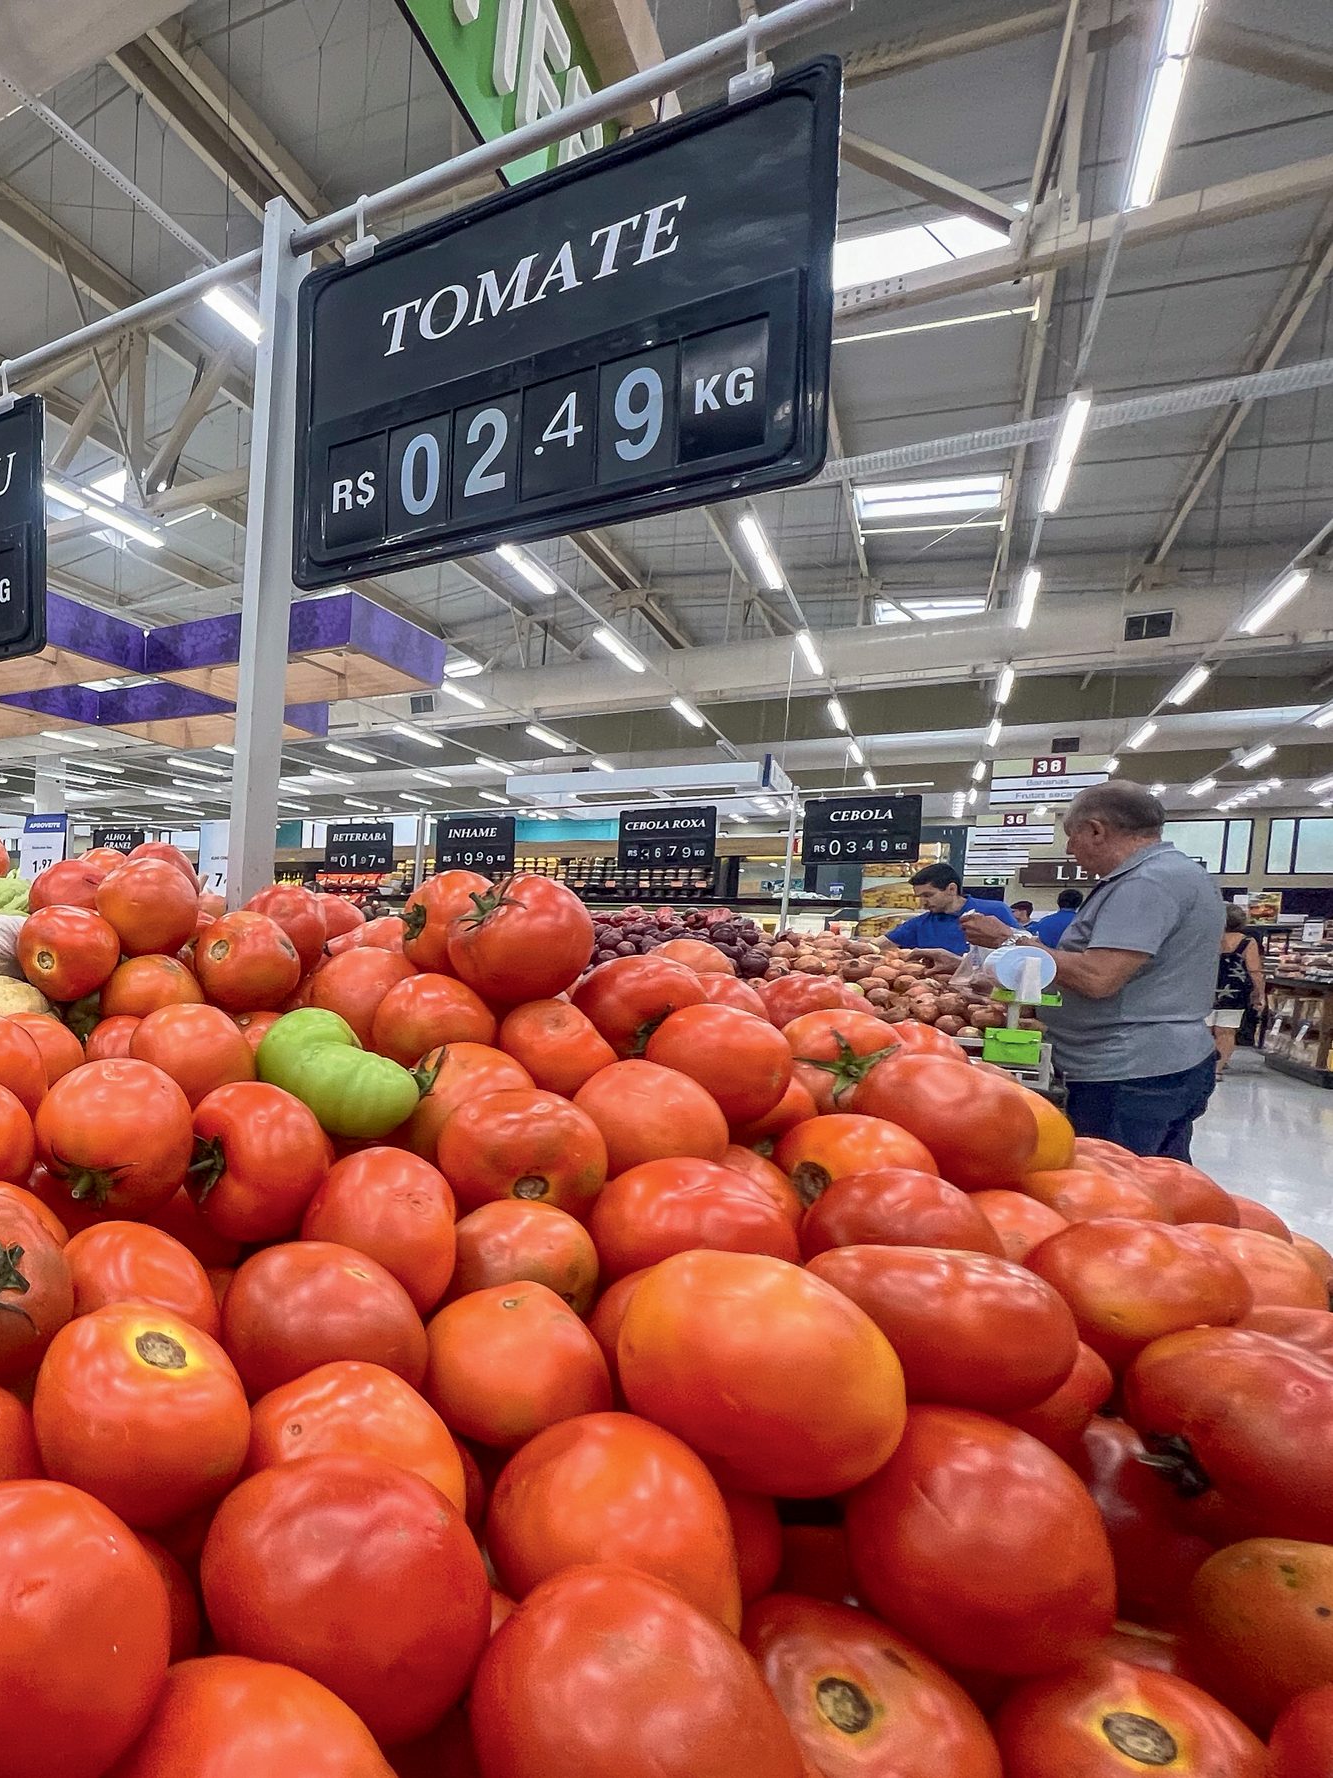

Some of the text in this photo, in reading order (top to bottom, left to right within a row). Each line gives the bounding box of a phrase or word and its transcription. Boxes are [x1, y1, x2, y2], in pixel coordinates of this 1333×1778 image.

[381, 196, 687, 358] TOMATE
[331, 470, 376, 514] R$
[694, 366, 755, 416] KG
[1036, 759, 1062, 773] 38
[1025, 778, 1071, 787] Bananas
[1015, 792, 1046, 800] Frutas
[829, 808, 894, 823] CEBOLA
[1006, 815, 1025, 825] 36
[624, 818, 706, 831] CEBOLA ROXA
[104, 833, 132, 841] ALHO A
[332, 832, 387, 842] BETERRABA
[447, 827, 498, 839] INHAME
[103, 841, 132, 850] GRANEL
[895, 842, 908, 850] KG
[694, 849, 706, 857] KG
